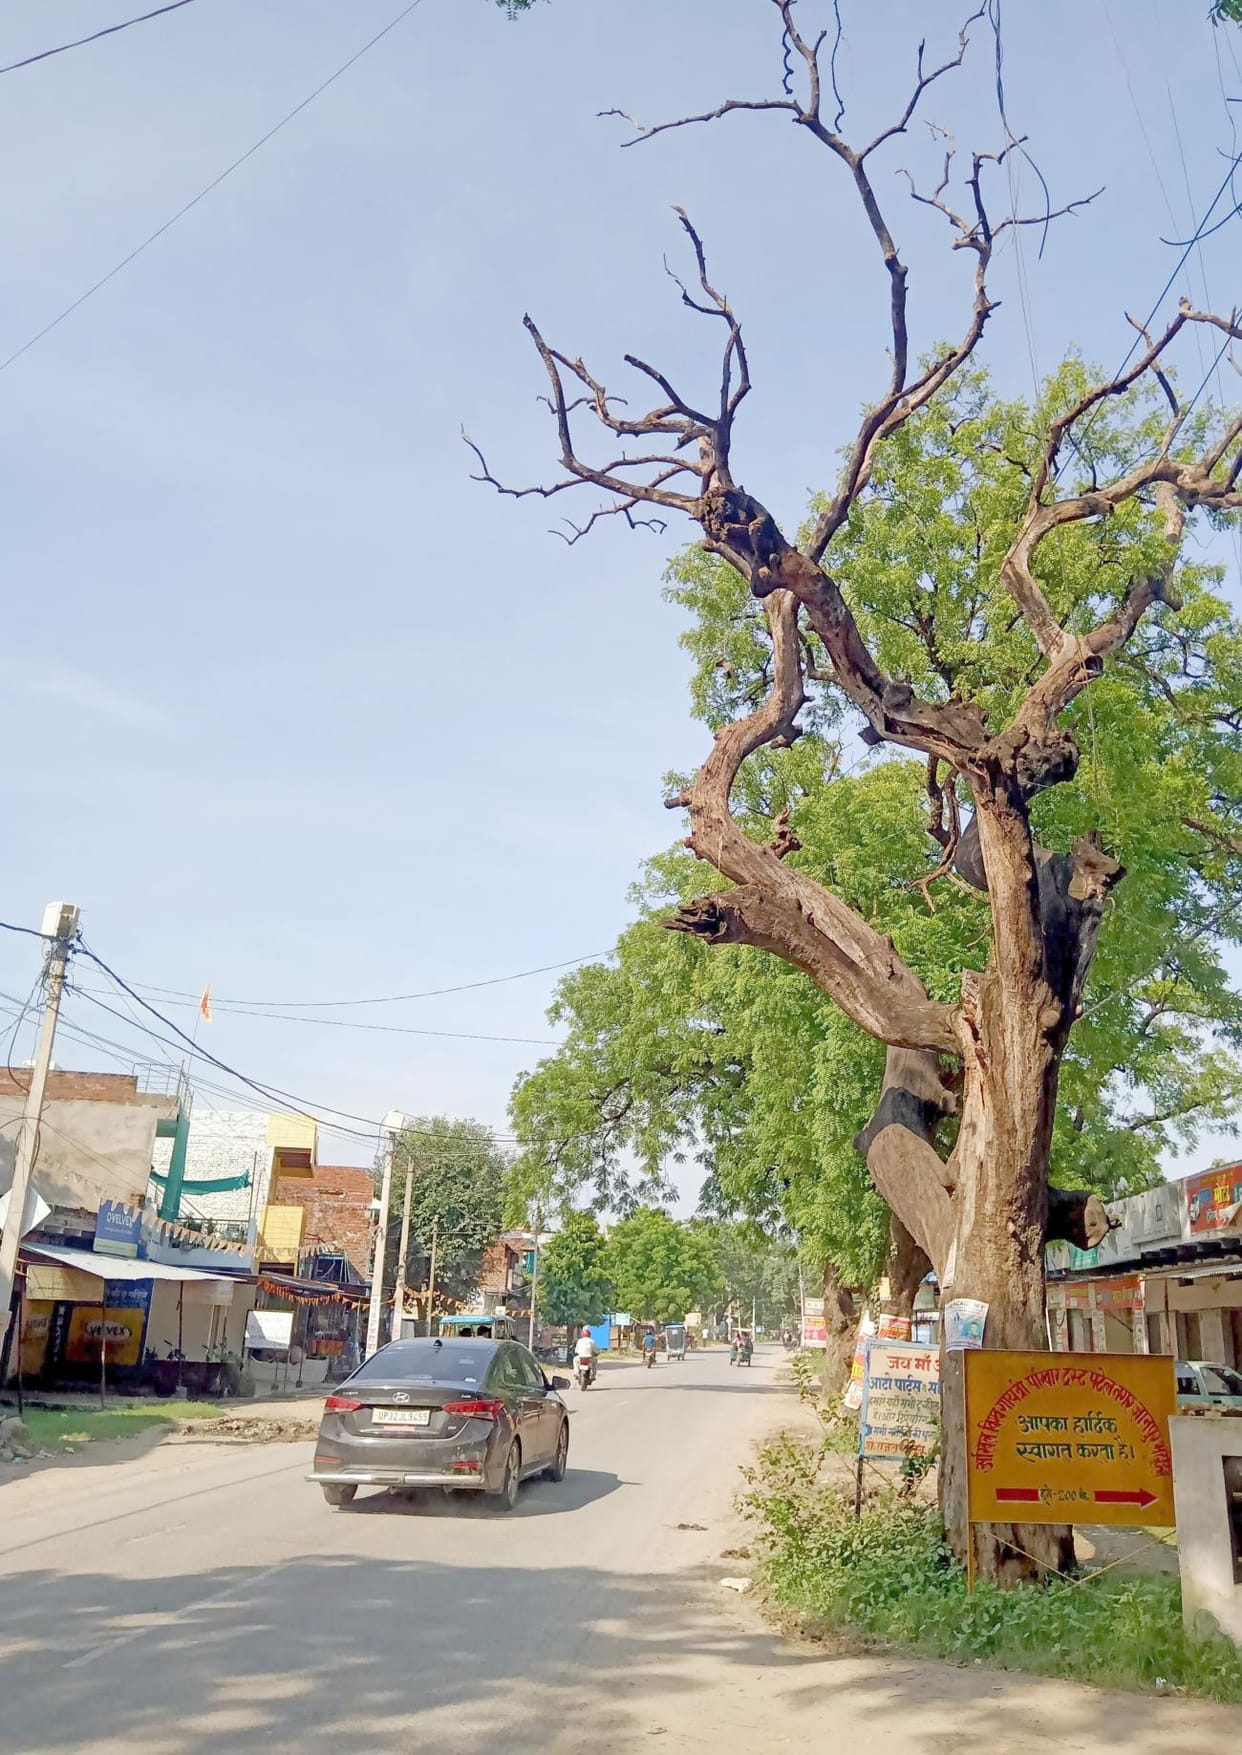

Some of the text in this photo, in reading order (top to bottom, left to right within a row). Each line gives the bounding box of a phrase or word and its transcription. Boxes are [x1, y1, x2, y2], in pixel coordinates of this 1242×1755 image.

[886, 1355, 913, 1370] जय
[1017, 1410, 1118, 1437] आपका हार्दिक
[1016, 1442, 1073, 1463] स्वागत
[1076, 1443, 1115, 1460] करता
